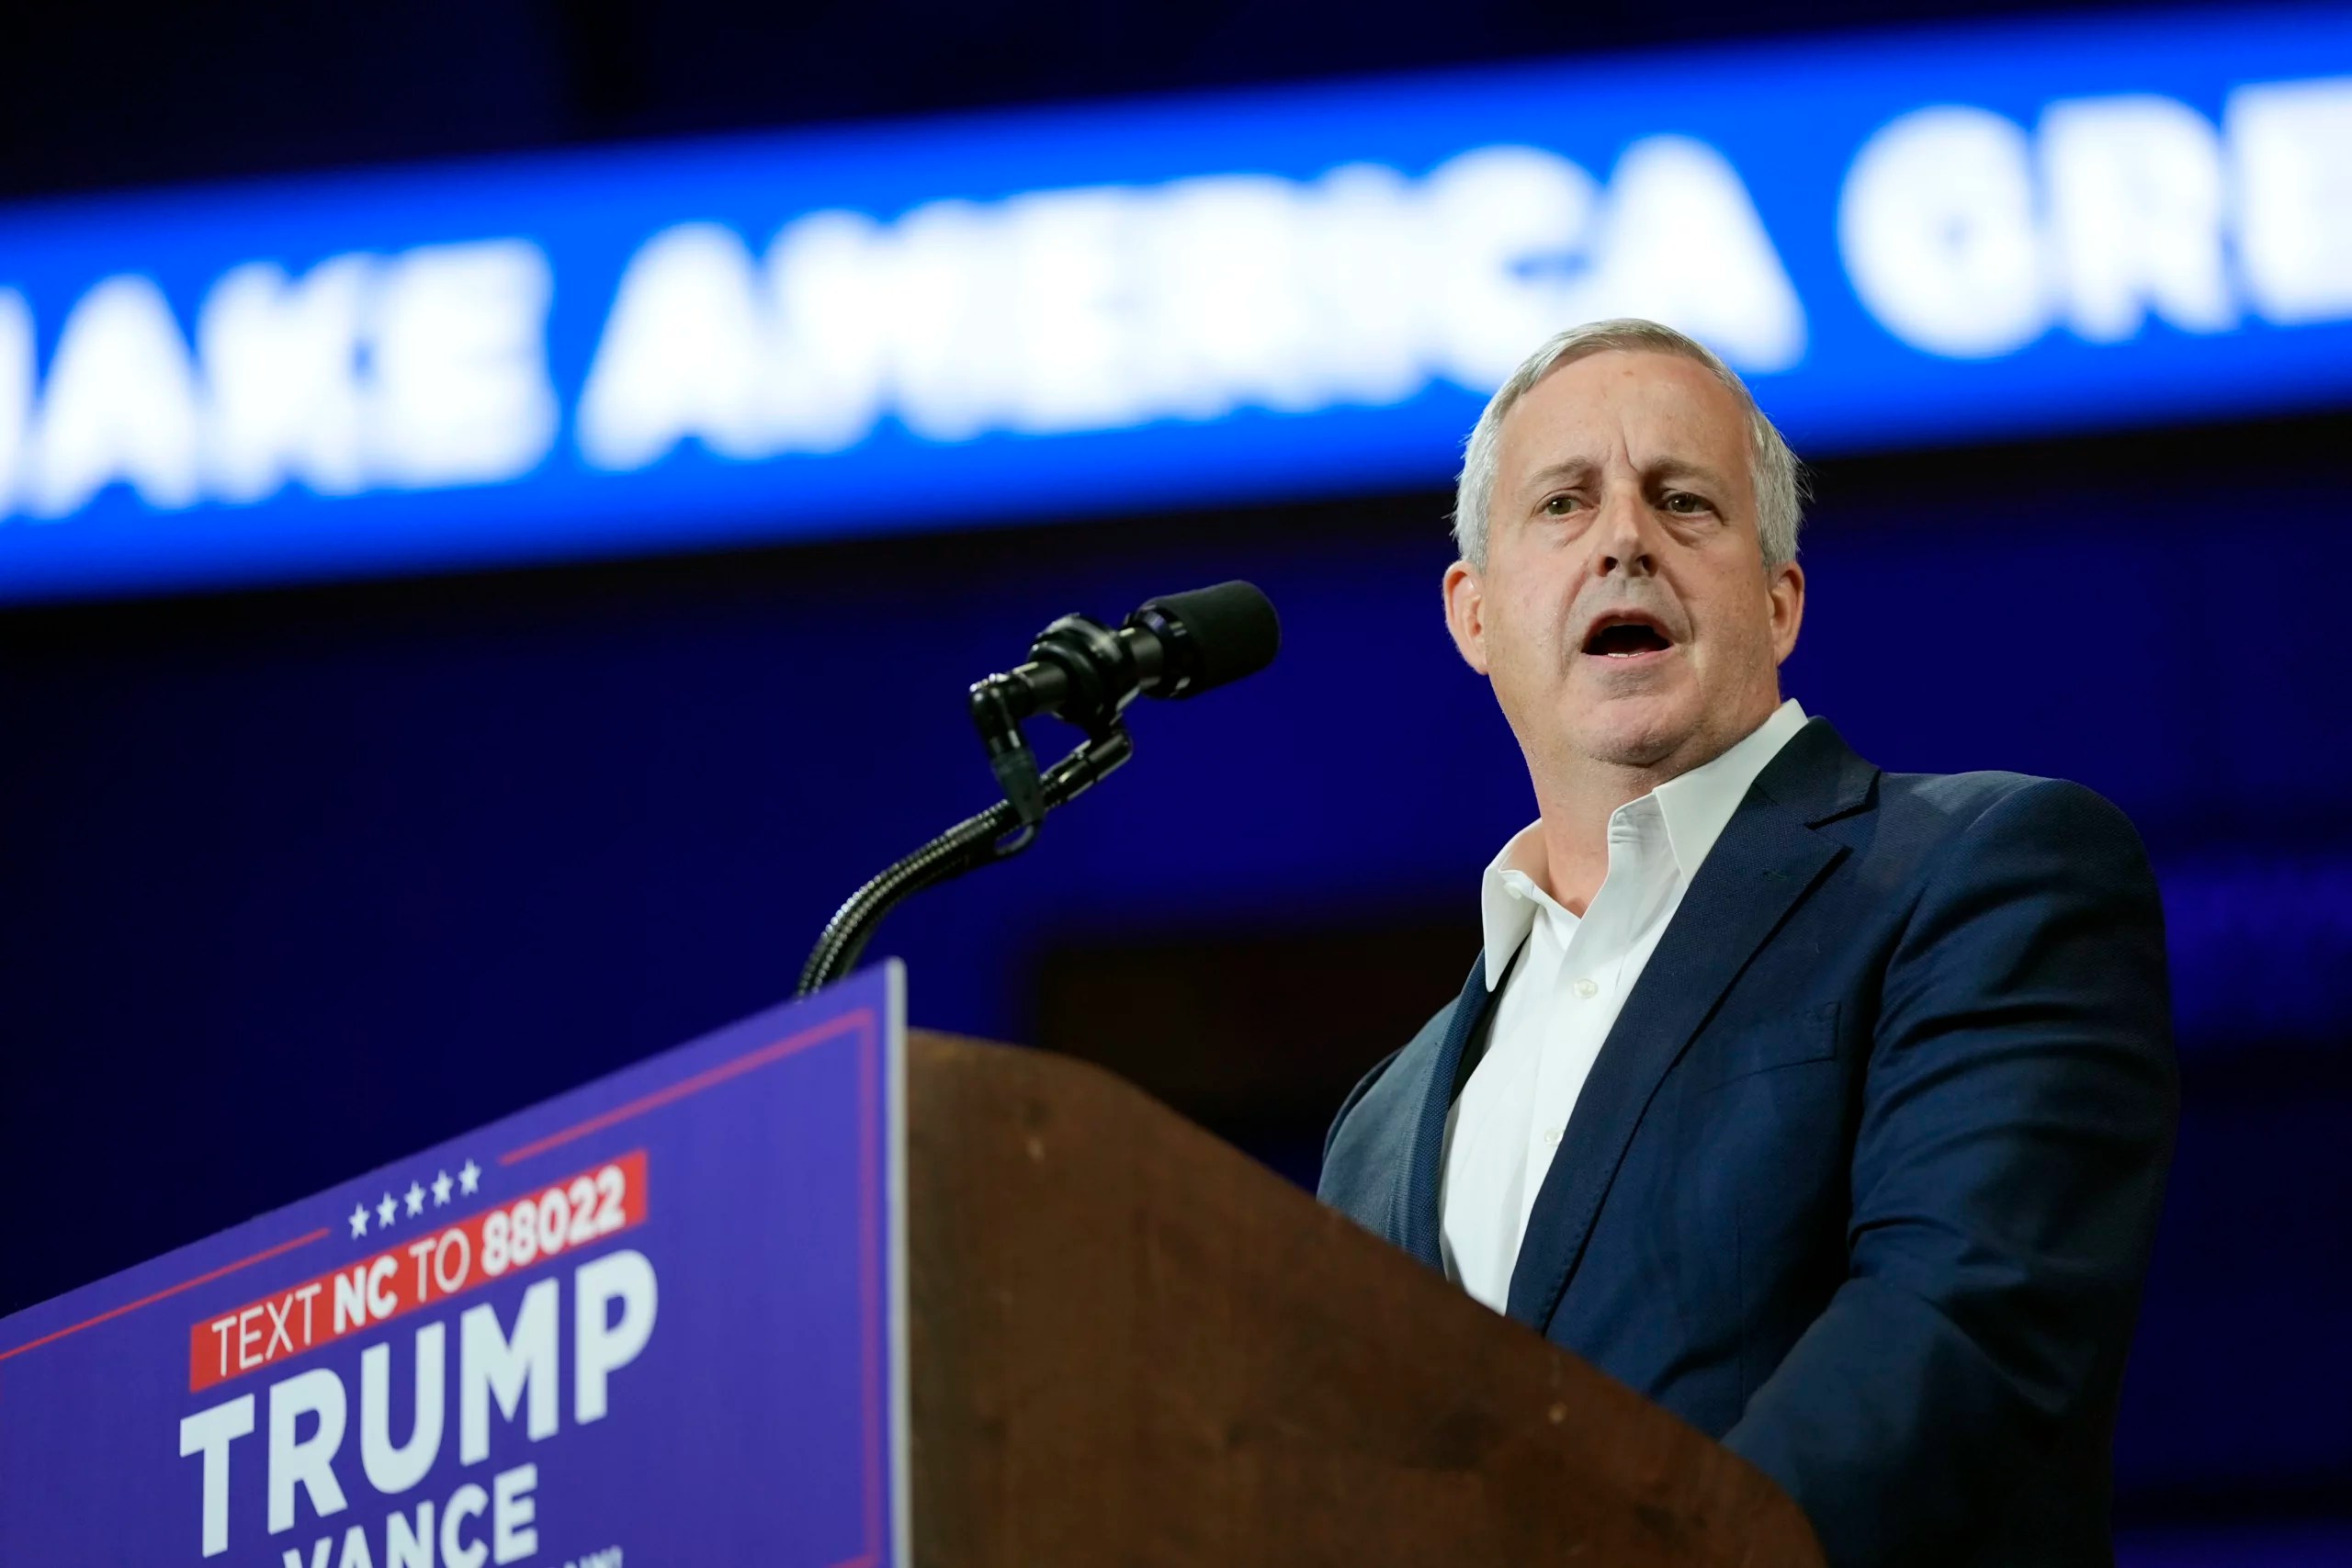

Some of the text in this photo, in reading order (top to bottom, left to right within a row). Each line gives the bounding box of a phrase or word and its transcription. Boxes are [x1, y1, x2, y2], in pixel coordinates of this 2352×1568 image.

[0, 237, 557, 516] AKE
[577, 138, 1804, 470] AMERICA
[210, 1166, 626, 1377] TEXT NC TO 88022
[179, 1250, 658, 1558] TRUMP
[282, 1462, 538, 1568] NCE
